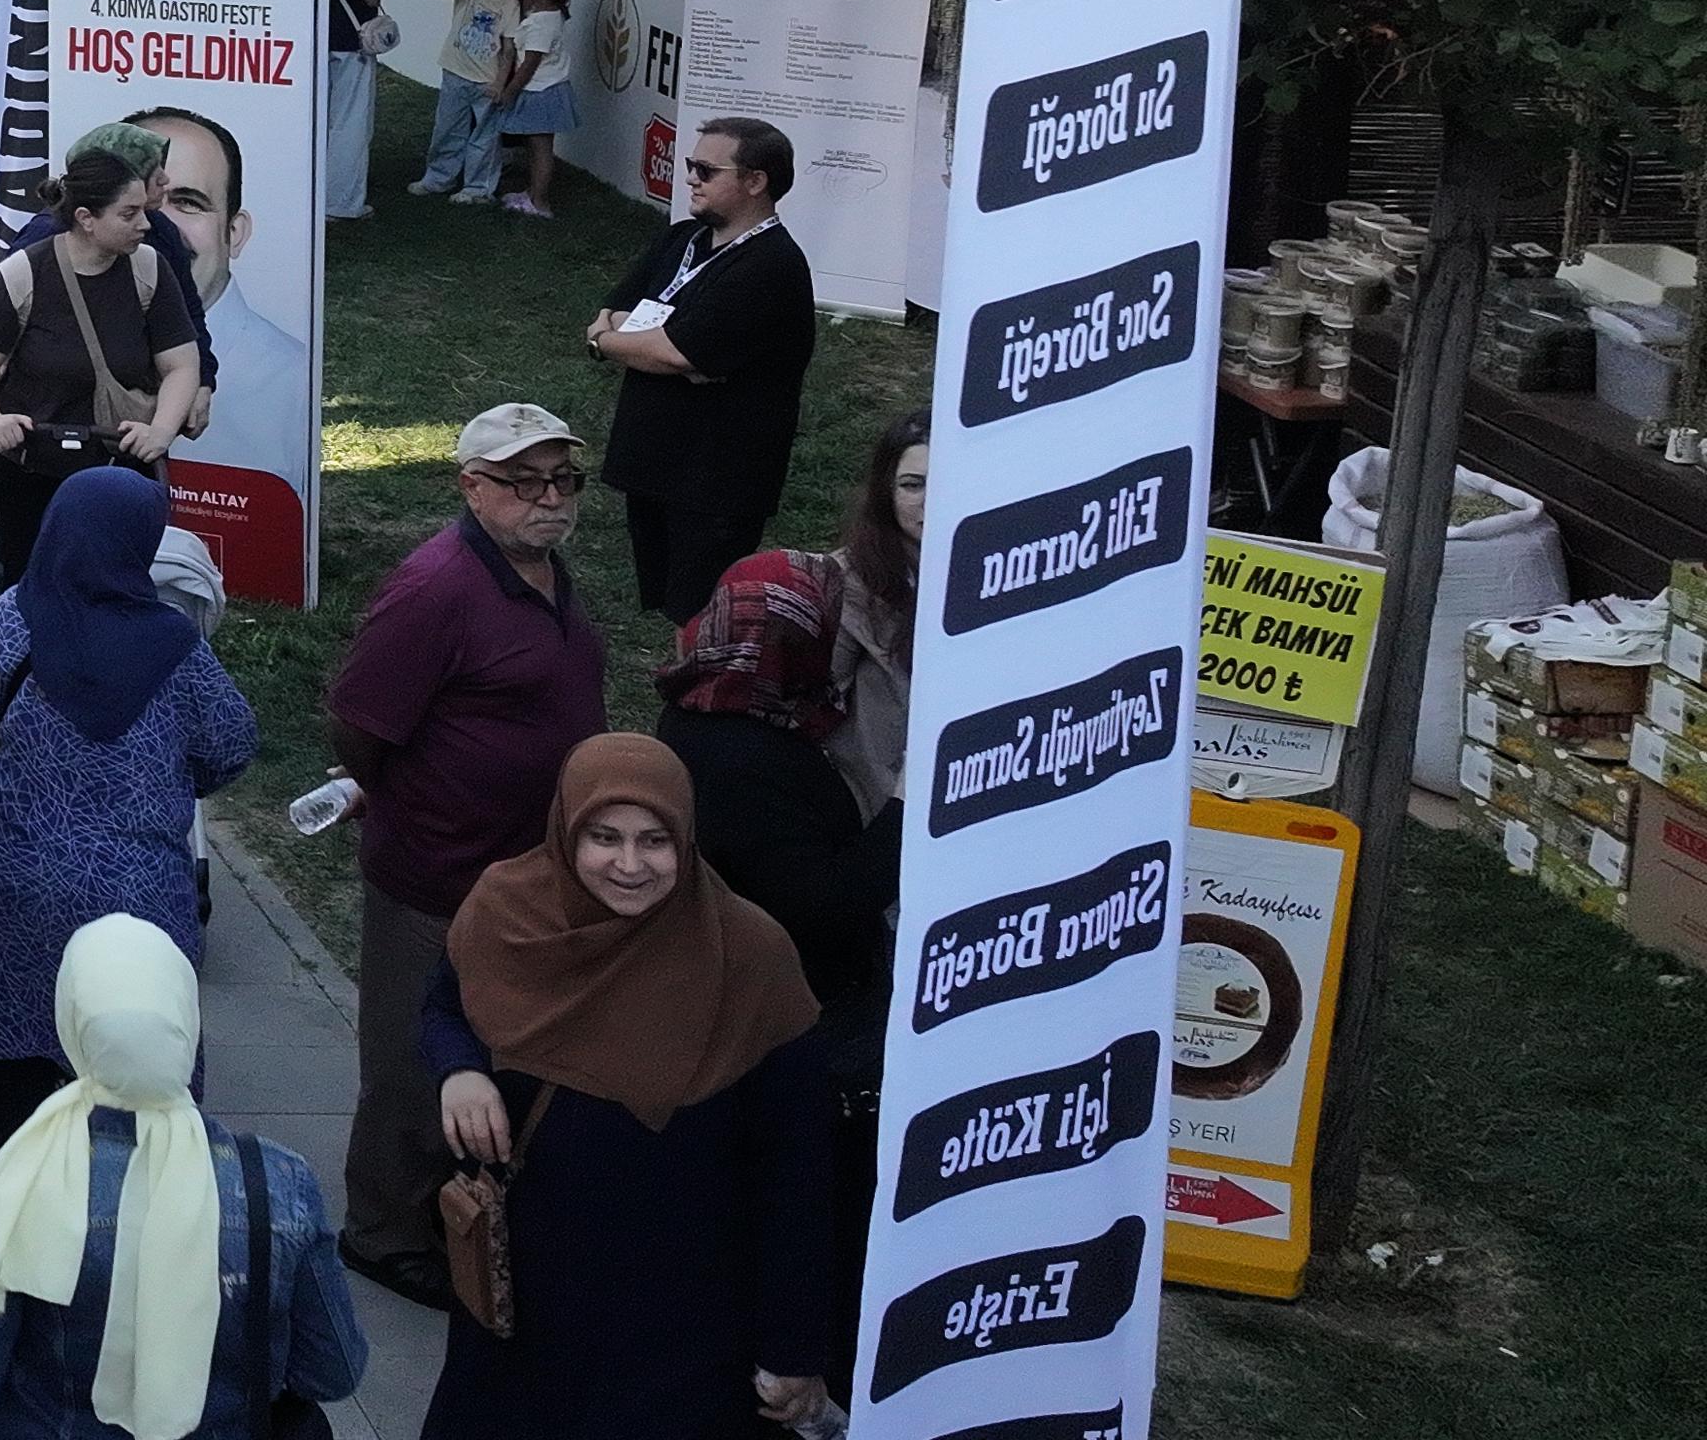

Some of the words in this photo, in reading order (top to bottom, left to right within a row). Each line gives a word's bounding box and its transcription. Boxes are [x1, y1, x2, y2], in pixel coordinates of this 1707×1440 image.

[160, 0, 218, 24] GASTRO
[68, 26, 135, 84] HOŞ
[142, 28, 295, 86] GELDİNİZ
[169, 484, 199, 502] him
[201, 490, 249, 509] ALTAY
[1202, 552, 1247, 589] ENİ
[1242, 565, 1363, 616] MAHSÜL
[1199, 603, 1252, 640] ÇEK
[1251, 615, 1355, 663] BAMYA
[1196, 652, 1277, 695] 2000
[1199, 878, 1323, 921] Kadayıfçısı
[1187, 1120, 1237, 1144] YERİ
